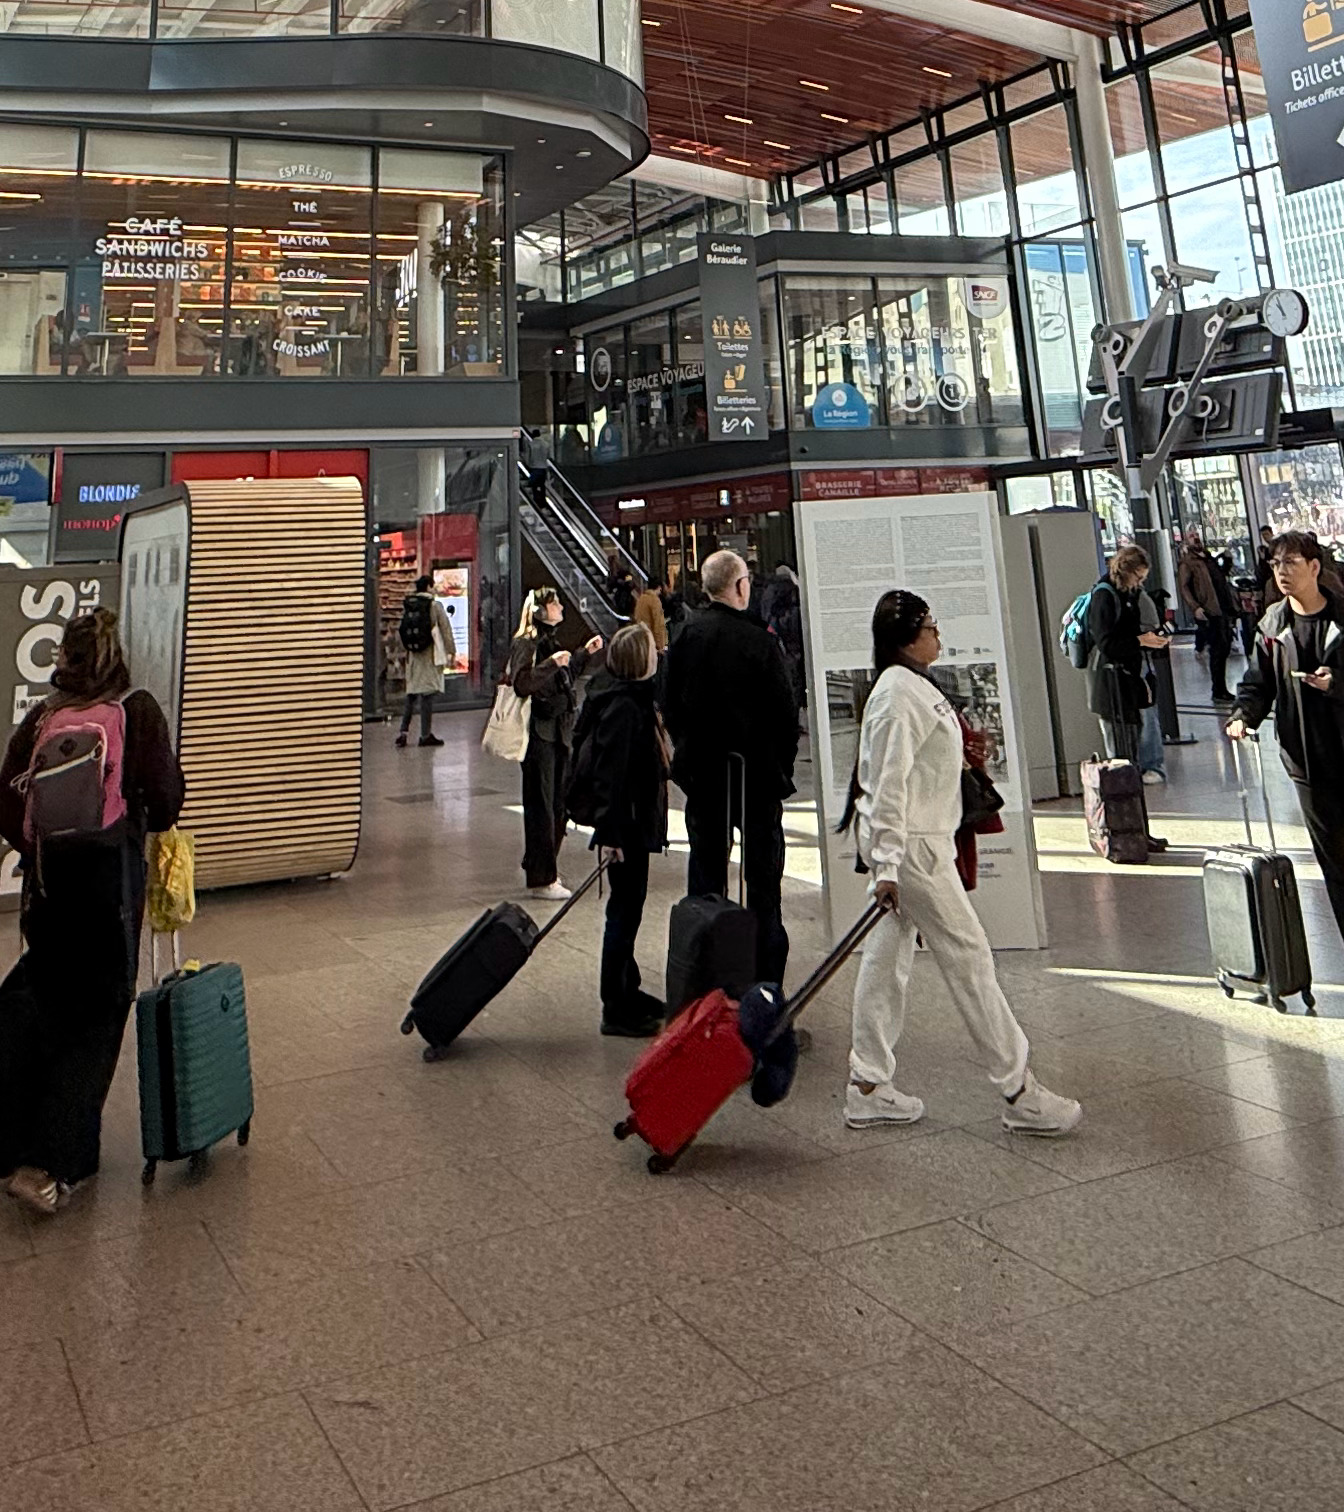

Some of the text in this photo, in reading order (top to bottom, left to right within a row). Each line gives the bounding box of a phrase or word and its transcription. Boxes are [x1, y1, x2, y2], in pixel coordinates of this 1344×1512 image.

[1285, 94, 1317, 115] Tickets
[279, 164, 332, 182] ESPRESSO
[292, 200, 318, 213] THÉ
[125, 217, 183, 235] CAFÉ
[278, 234, 330, 247] MATCHA
[94, 239, 208, 258] SANDWICHS
[711, 242, 742, 254] Galerie
[706, 254, 748, 266] Béraudier
[102, 259, 200, 280] PÂTISSERIES
[278, 268, 328, 283] COOKIE
[973, 290, 997, 300] SNCF
[284, 305, 321, 317] CAKE
[821, 326, 875, 339] ESPACE
[272, 339, 331, 358] CROISSANT
[717, 341, 749, 352] Toilettes
[627, 373, 659, 393] ESPACE
[717, 395, 757, 406] Billetteries
[815, 480, 862, 489] BRASSERIE
